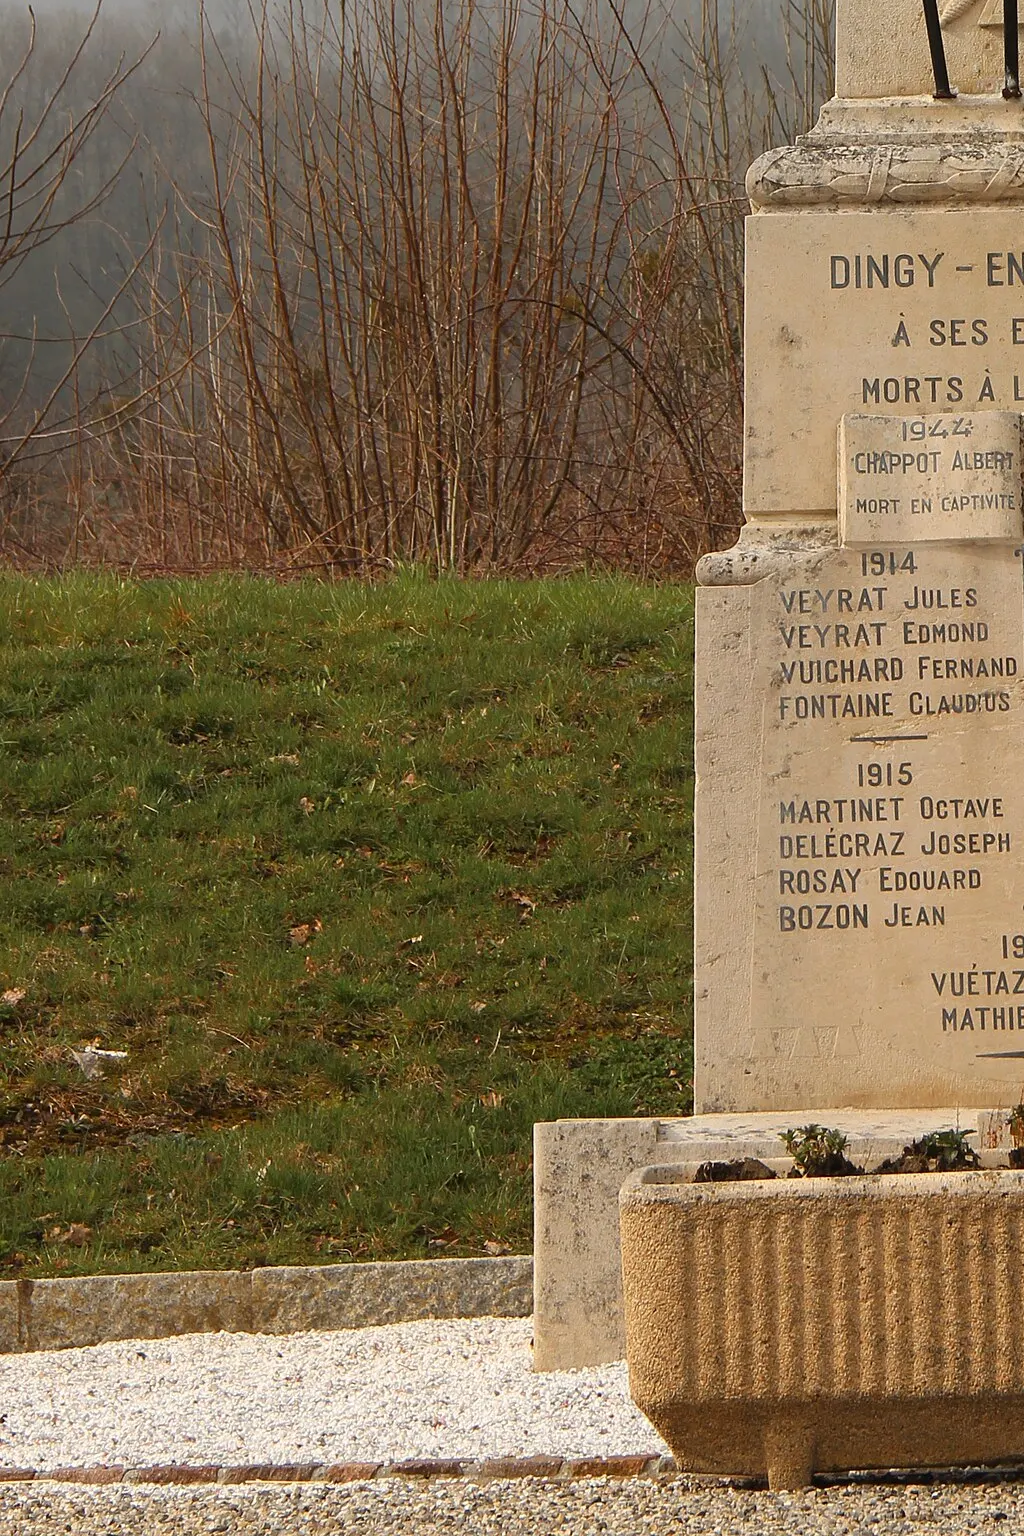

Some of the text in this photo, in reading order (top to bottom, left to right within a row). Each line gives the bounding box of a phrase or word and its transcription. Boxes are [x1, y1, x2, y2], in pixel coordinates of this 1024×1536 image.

[830, 253, 945, 289] DINGY
[891, 312, 910, 347] À
[929, 319, 989, 347] SES
[862, 376, 964, 403] MORTS
[978, 368, 995, 401] À
[902, 420, 974, 441] 1944
[855, 450, 1014, 475] CHAPPOT ALBERT
[856, 499, 900, 514] MORT
[911, 498, 932, 514] EN
[862, 551, 918, 576] 1914
[779, 586, 977, 613] VEYRAT JULES
[779, 622, 988, 648] VEYRAT EDMOND
[781, 657, 1017, 684] VUICHARD FERNAND
[779, 692, 1010, 720] FONTAINE CLAUDIUS
[858, 763, 913, 787] 1915
[780, 797, 1004, 824] MARTINET OCTAVE
[780, 828, 1010, 859] DELÉCRAZ JOSEPH
[780, 868, 981, 894] ROSAY EDOUARD
[780, 903, 945, 932] BOZON JEAN
